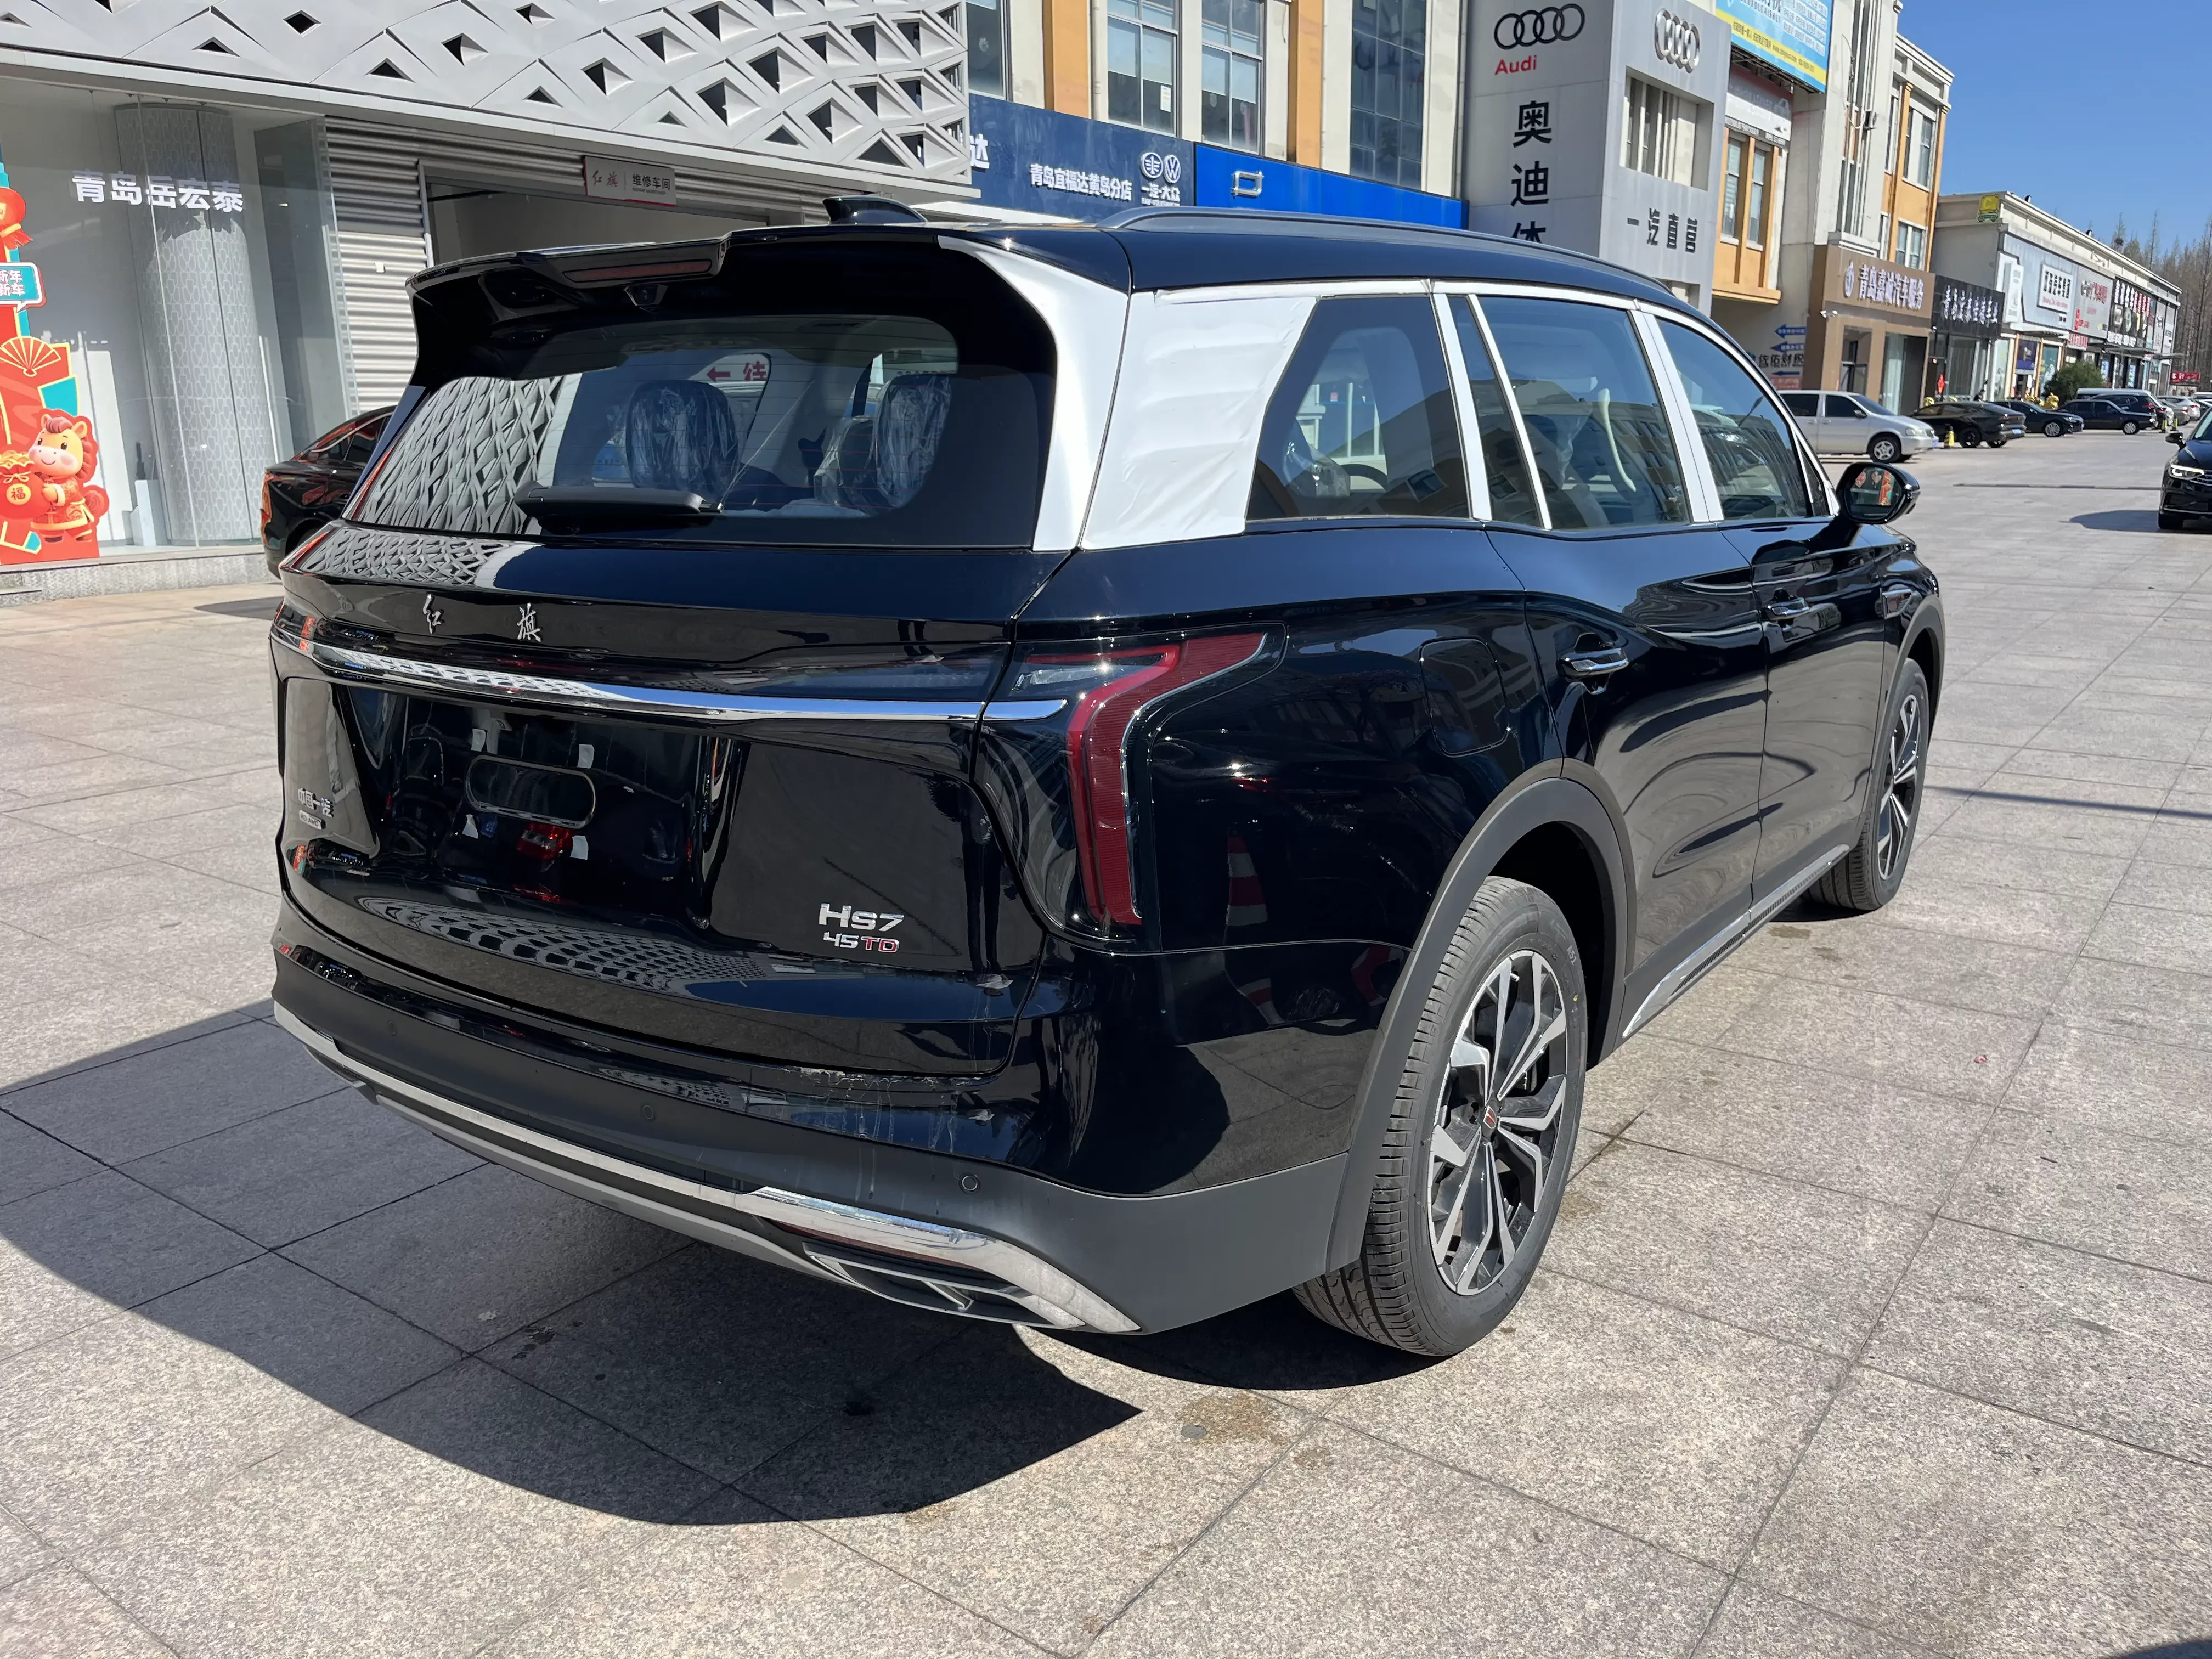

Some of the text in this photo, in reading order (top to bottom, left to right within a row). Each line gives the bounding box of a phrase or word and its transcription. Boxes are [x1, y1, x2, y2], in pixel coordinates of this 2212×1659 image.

[1494, 55, 1537, 75] Audi
[72, 168, 244, 212] 青岛岳宏泰
[592, 170, 671, 190] 红旗 维修车间
[1030, 163, 1132, 201] 青岛宜福达黄岛分店
[1627, 207, 1698, 253] 一汽直营
[11, 487, 26, 500] 福
[423, 594, 541, 642] 红旗
[298, 788, 332, 818] 中国一汽
[823, 932, 900, 953] 45TD
